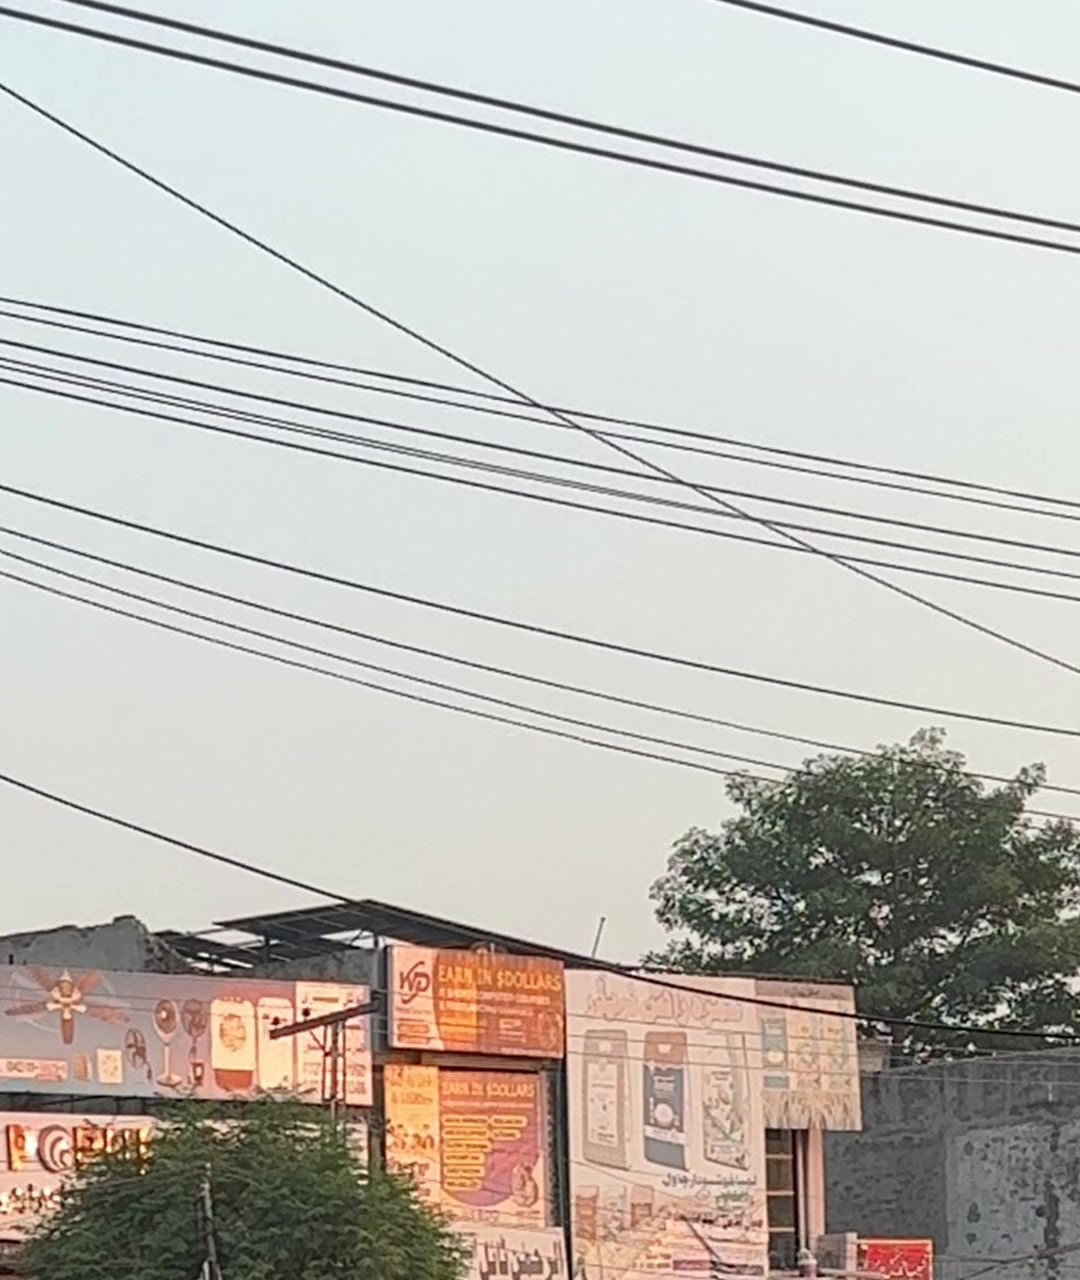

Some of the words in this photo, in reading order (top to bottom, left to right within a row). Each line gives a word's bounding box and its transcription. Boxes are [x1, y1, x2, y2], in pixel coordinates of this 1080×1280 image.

[438, 965, 473, 984] EARN
[477, 970, 492, 986] IN
[497, 971, 562, 991] $DOLLARS
